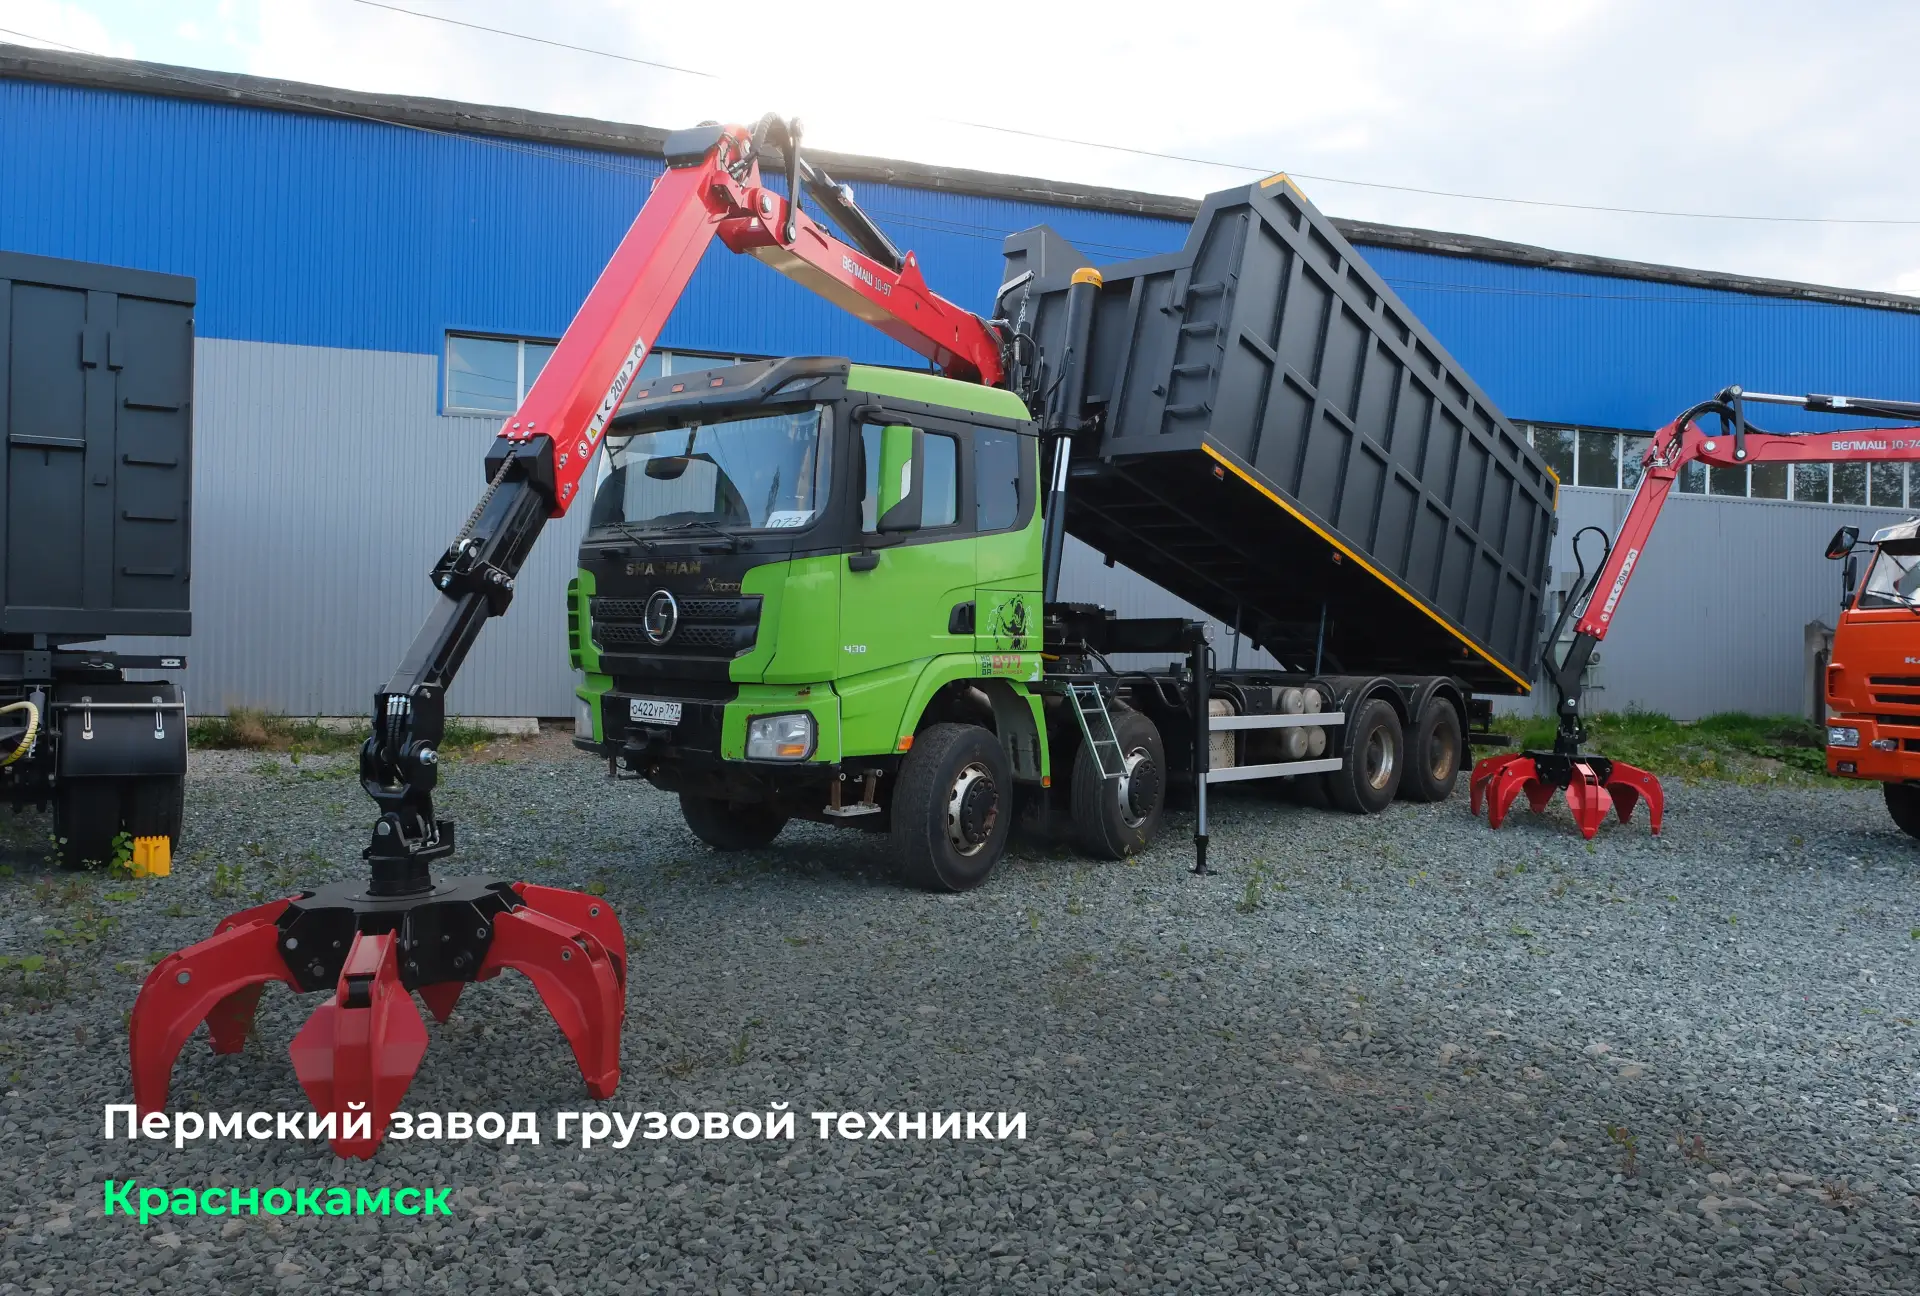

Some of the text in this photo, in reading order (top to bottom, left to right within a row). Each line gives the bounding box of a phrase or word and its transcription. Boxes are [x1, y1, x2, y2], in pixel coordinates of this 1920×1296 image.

[842, 255, 892, 297] ВЕЛМАШ 10-97
[1831, 440, 1887, 451] ВЕЛМАШ
[844, 644, 866, 654] 430
